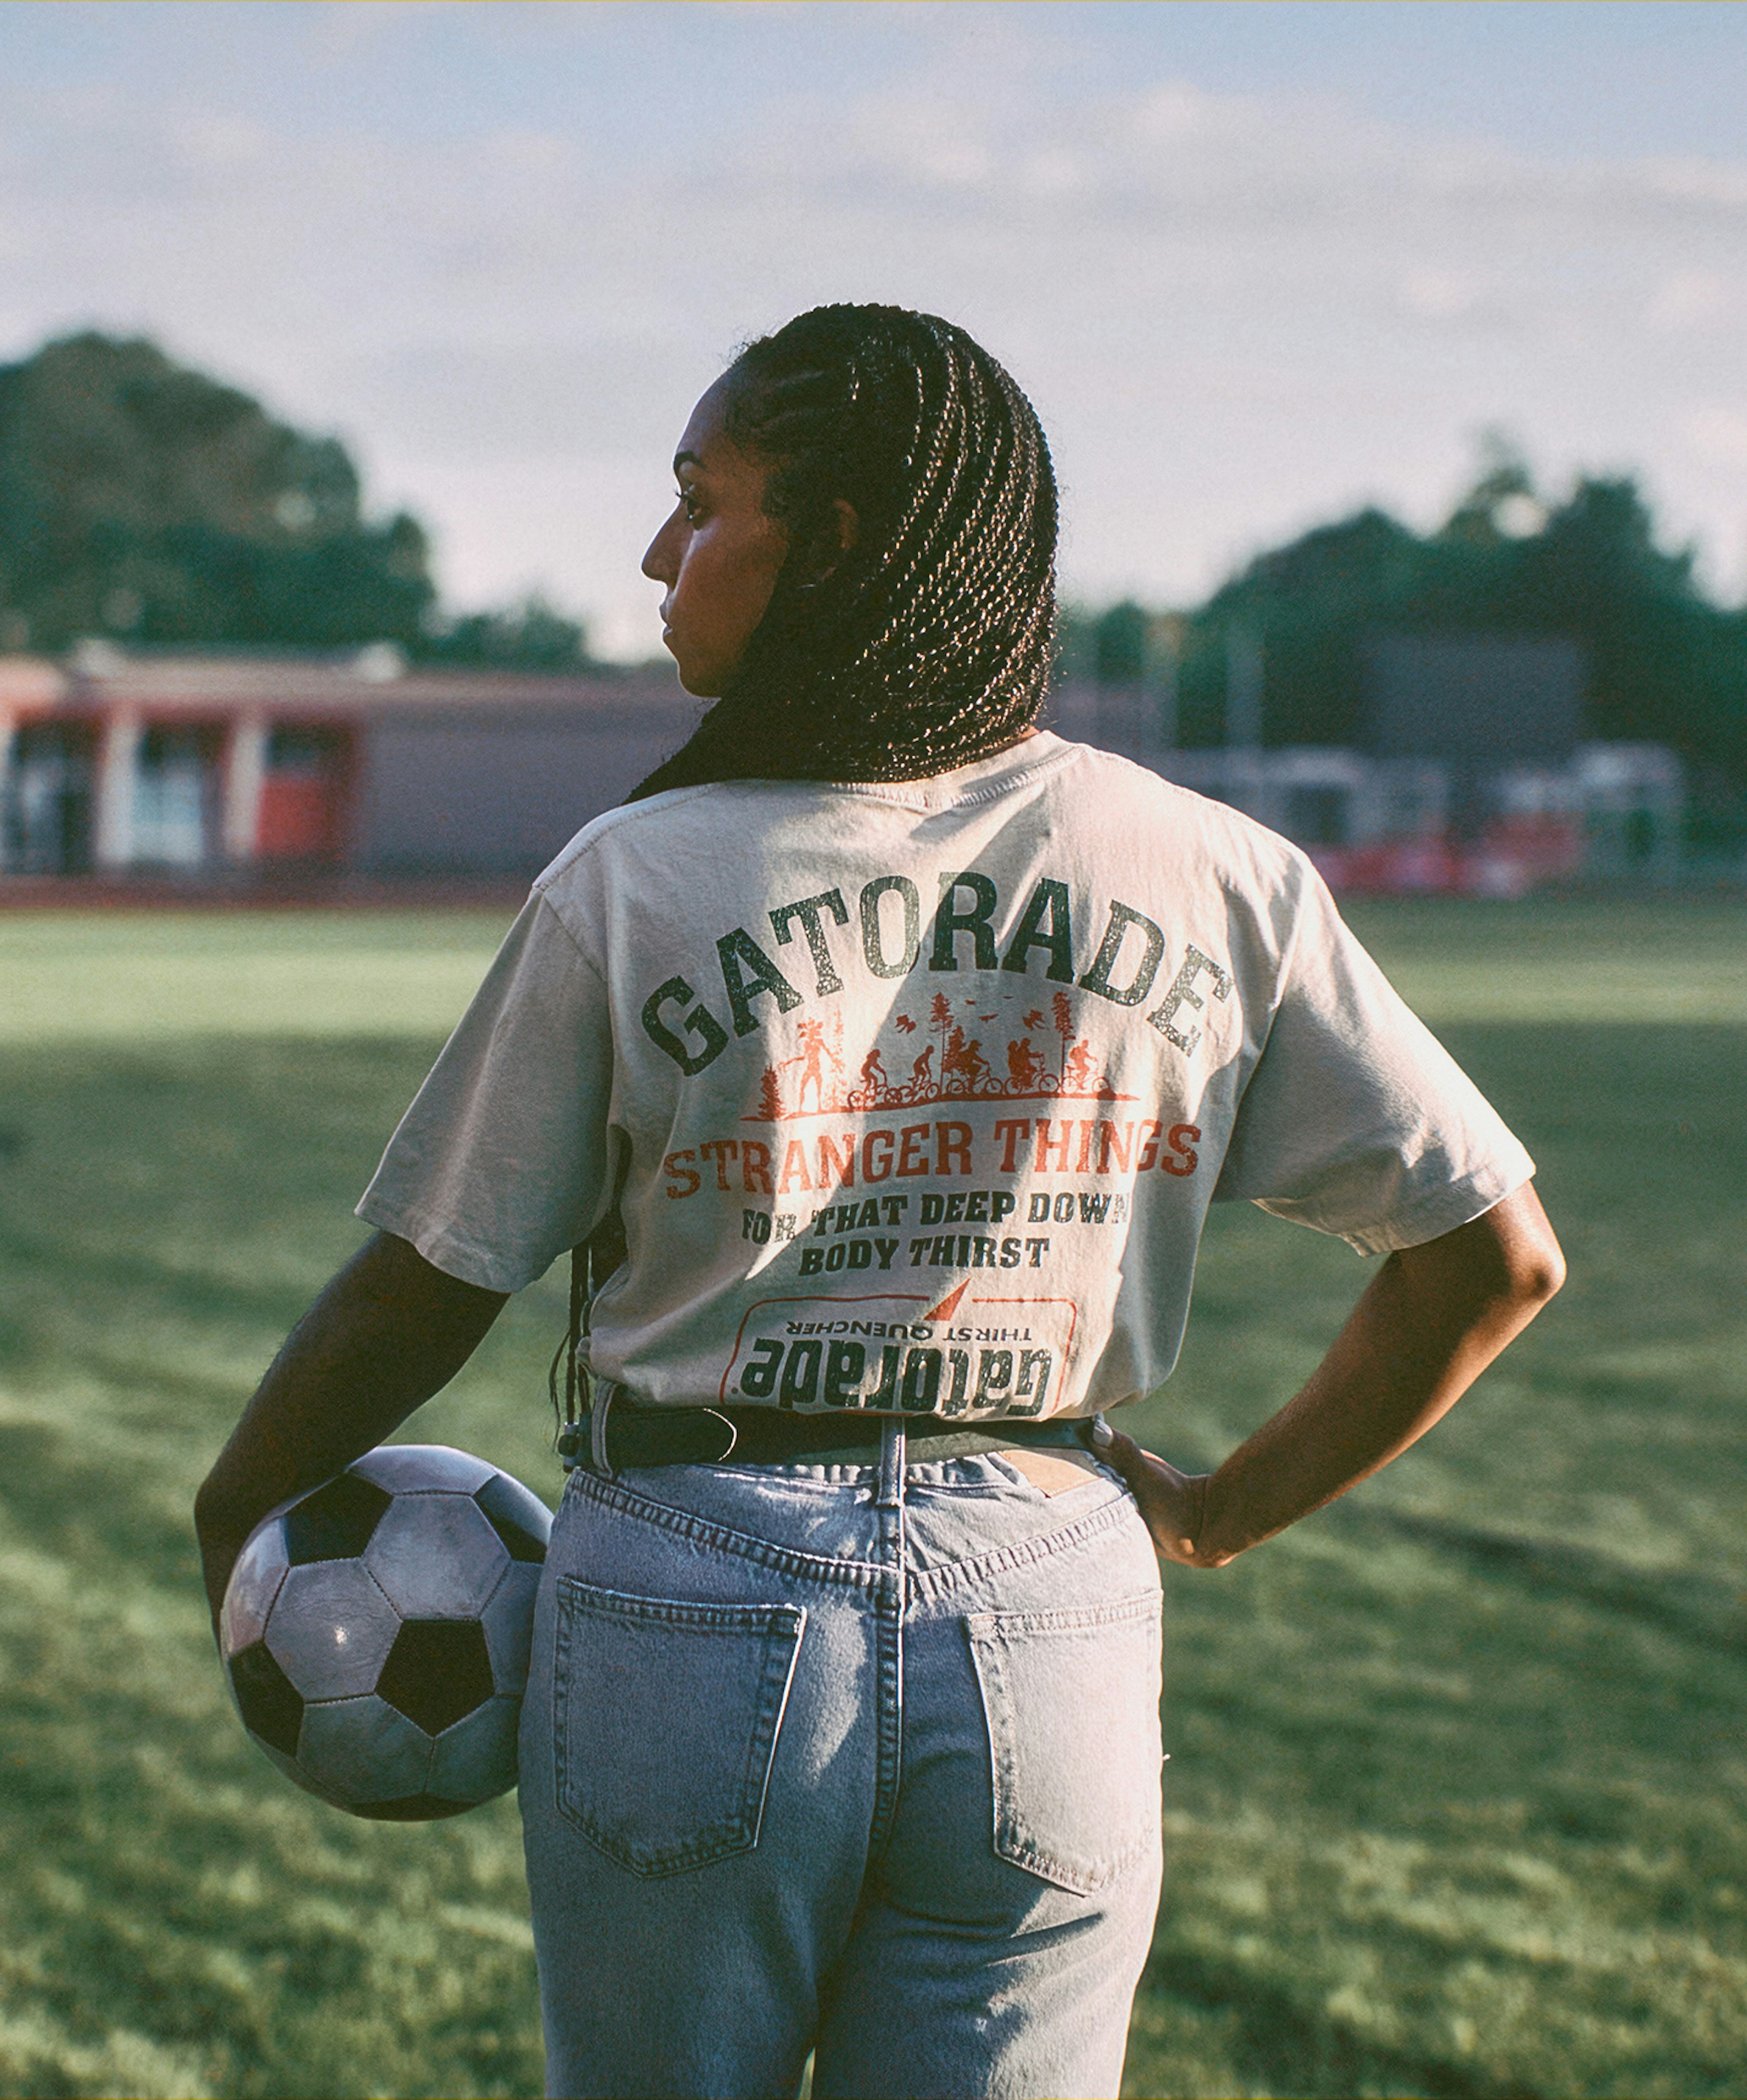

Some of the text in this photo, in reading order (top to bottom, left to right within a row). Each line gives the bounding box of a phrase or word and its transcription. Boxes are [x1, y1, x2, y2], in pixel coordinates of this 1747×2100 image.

[641, 871, 1234, 1077] GATORADE
[663, 1117, 1202, 1200] STRANGER THINGS
[741, 1208, 797, 1245] FOR
[811, 1195, 908, 1237] THAT
[920, 1191, 1016, 1225] DEEP
[798, 1234, 1050, 1276] BODY THIRST
[786, 1320, 1032, 1342] THIRST QUENCHER
[739, 1337, 1053, 1416] Gatorade
